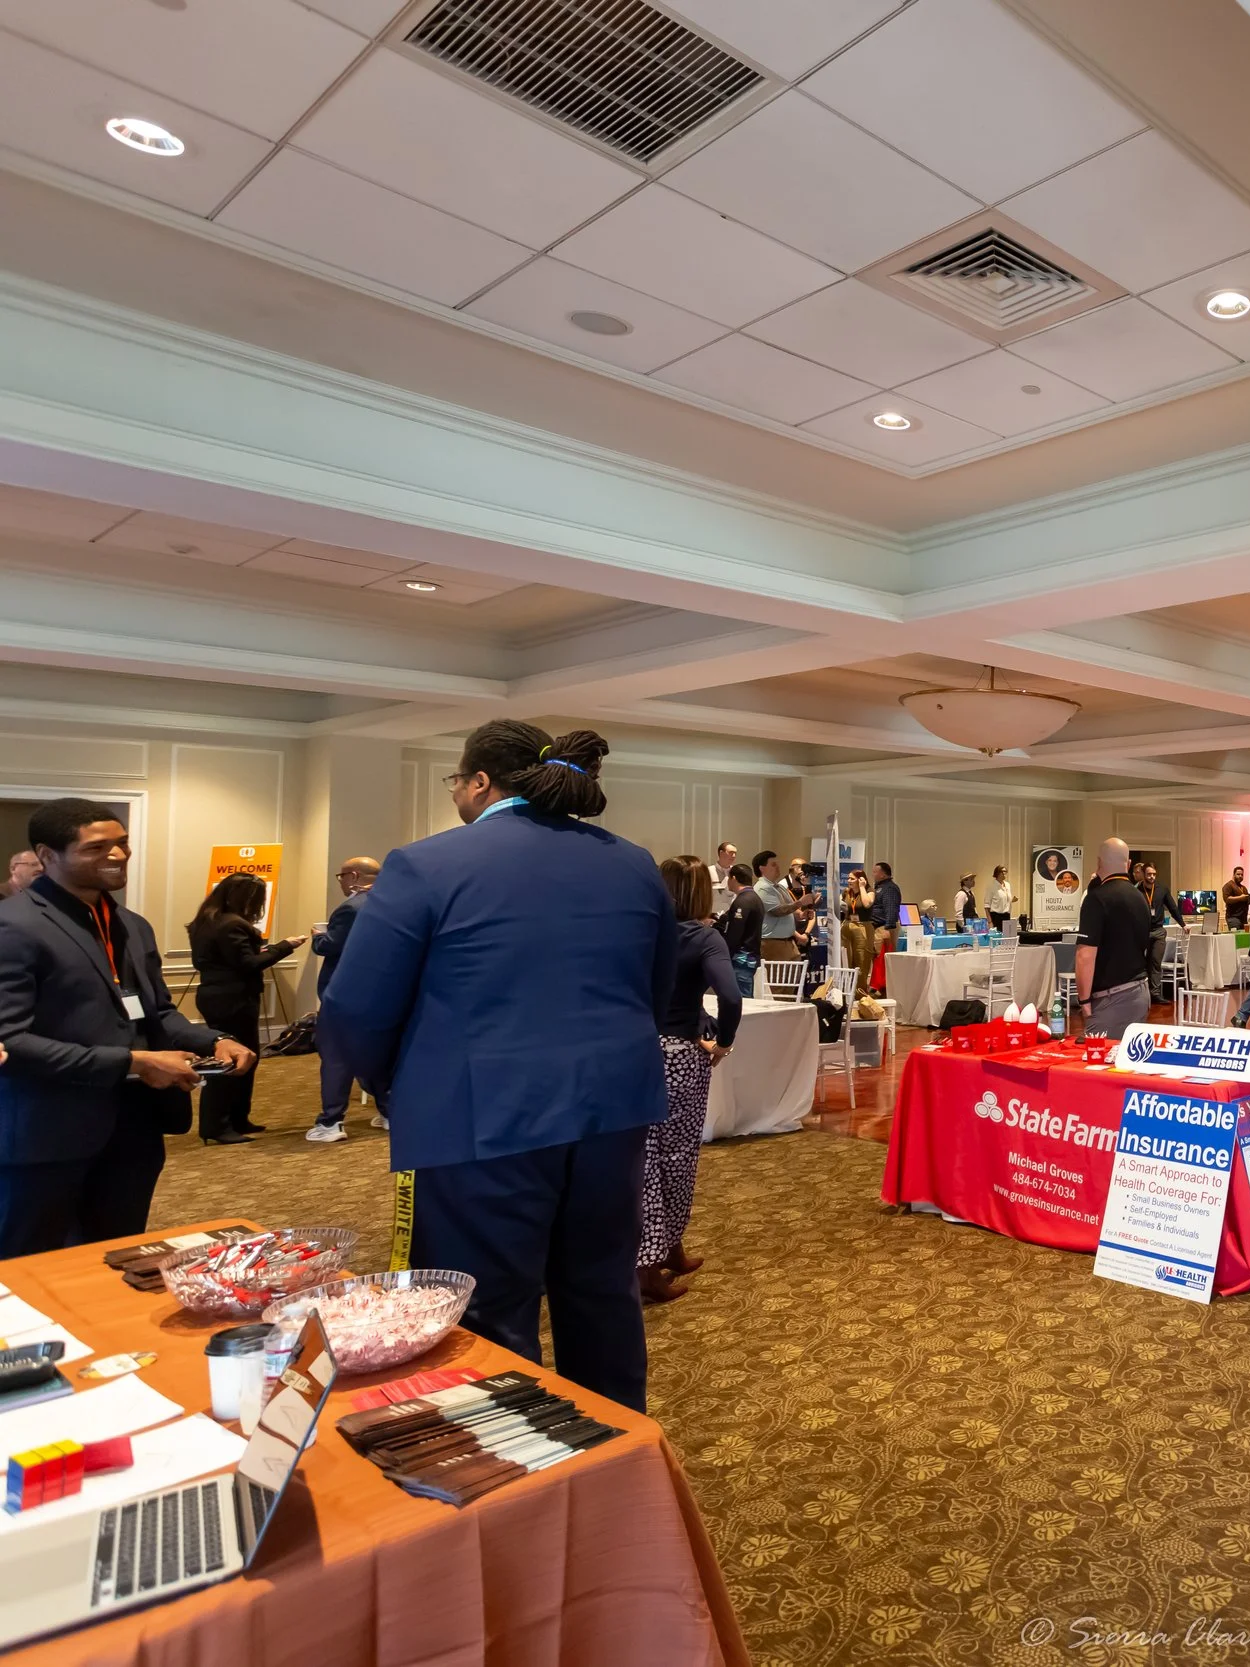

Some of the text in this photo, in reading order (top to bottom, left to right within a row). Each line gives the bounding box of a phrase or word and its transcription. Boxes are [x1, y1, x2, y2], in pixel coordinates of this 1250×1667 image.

[217, 864, 272, 873] WELCOME
[1198, 1057, 1245, 1070] ADVISORS
[1124, 1092, 1235, 1130] Affordable
[1120, 1127, 1229, 1168] Insurance
[1008, 1152, 1084, 1184] Michael Groves
[1119, 1158, 1222, 1188] A Smart Approach to
[1013, 1172, 1076, 1200] 484-674-7034
[1114, 1174, 1221, 1206] Health Coverage For:
[397, 1171, 412, 1236] F-WHITE
[994, 1184, 1099, 1225] www.grovesinsurance.net
[1130, 1205, 1178, 1222] Self-Employed
[1132, 1193, 1210, 1217] Small Business Owners
[1128, 1216, 1154, 1229] Families
[1164, 1225, 1199, 1239] Individuals
[1119, 1232, 1132, 1240] FREE
[1133, 1236, 1149, 1244] Quote
[1150, 1239, 1168, 1249] Contact
[1197, 1251, 1212, 1259] Agent
